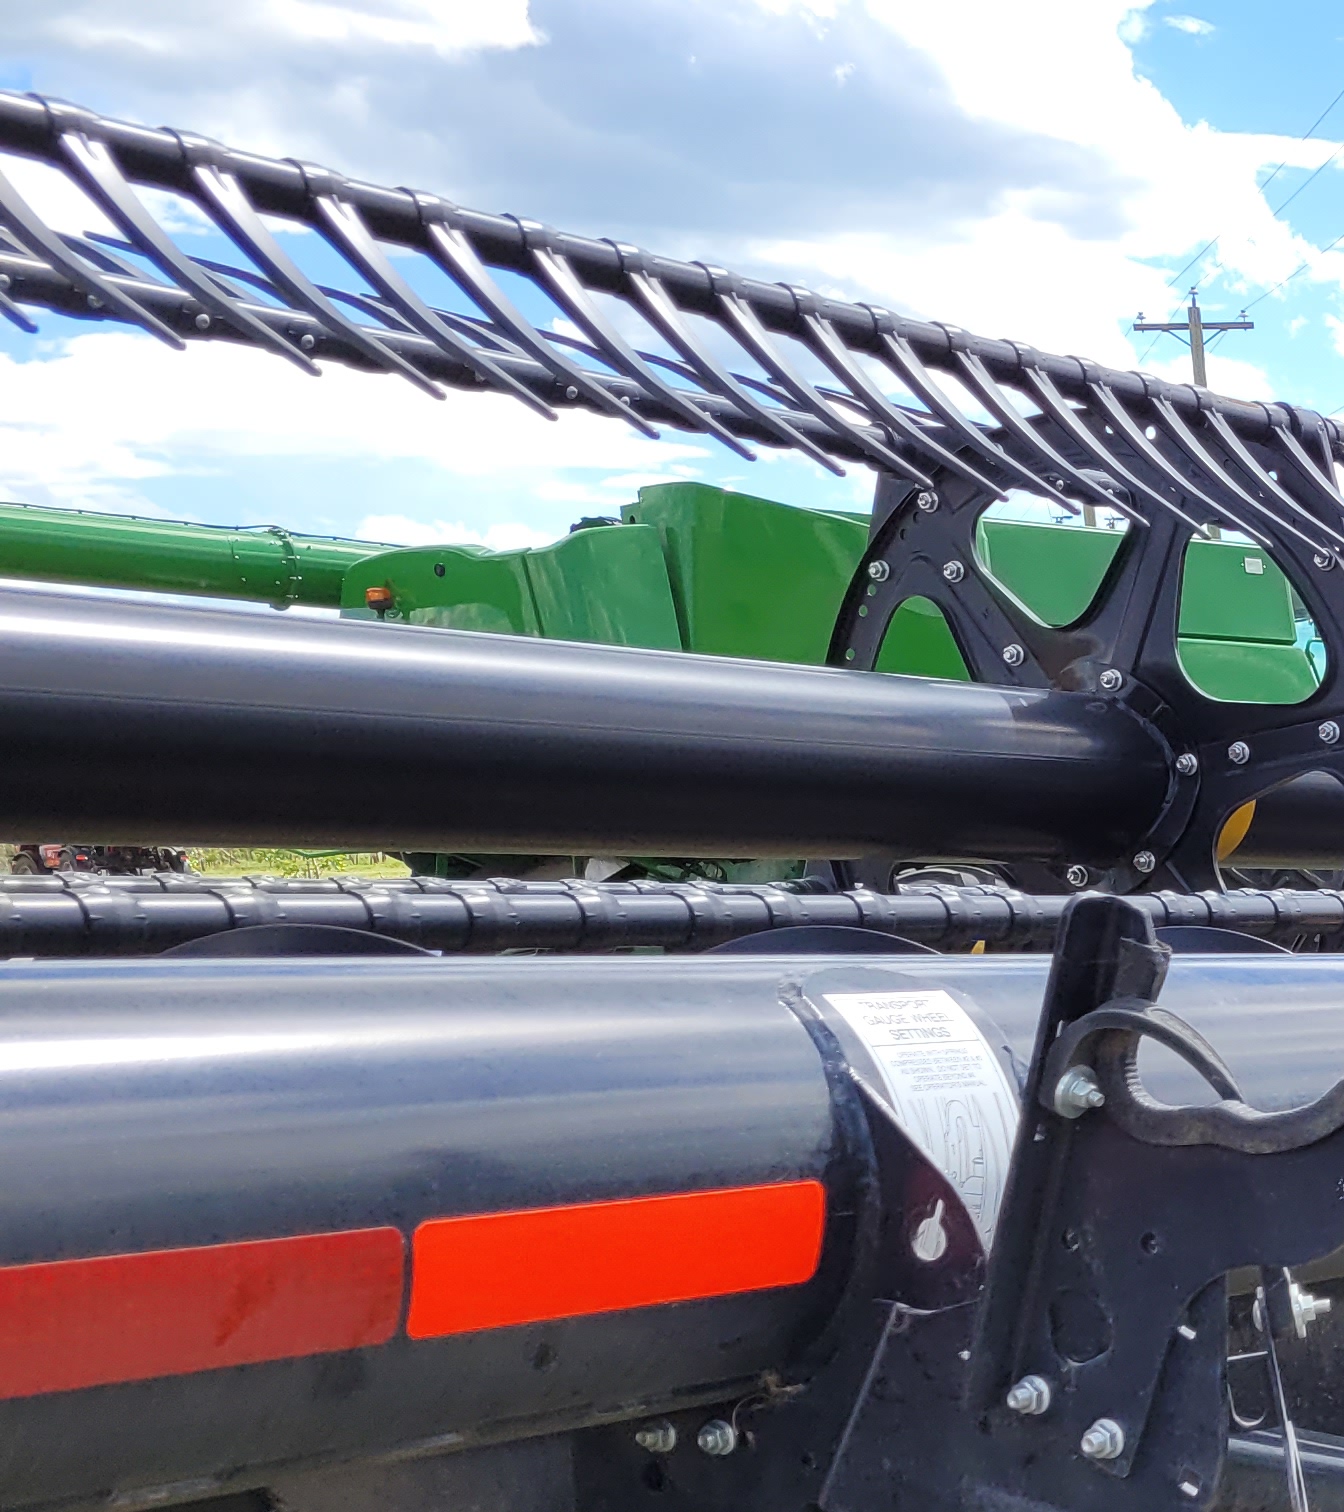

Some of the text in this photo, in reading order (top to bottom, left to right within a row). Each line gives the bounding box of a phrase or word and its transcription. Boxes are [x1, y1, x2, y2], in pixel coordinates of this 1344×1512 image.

[857, 999, 929, 1010] TRANSPORT
[862, 1012, 955, 1026] GAUGE WHEEL
[888, 1026, 951, 1040] SETTINGS
